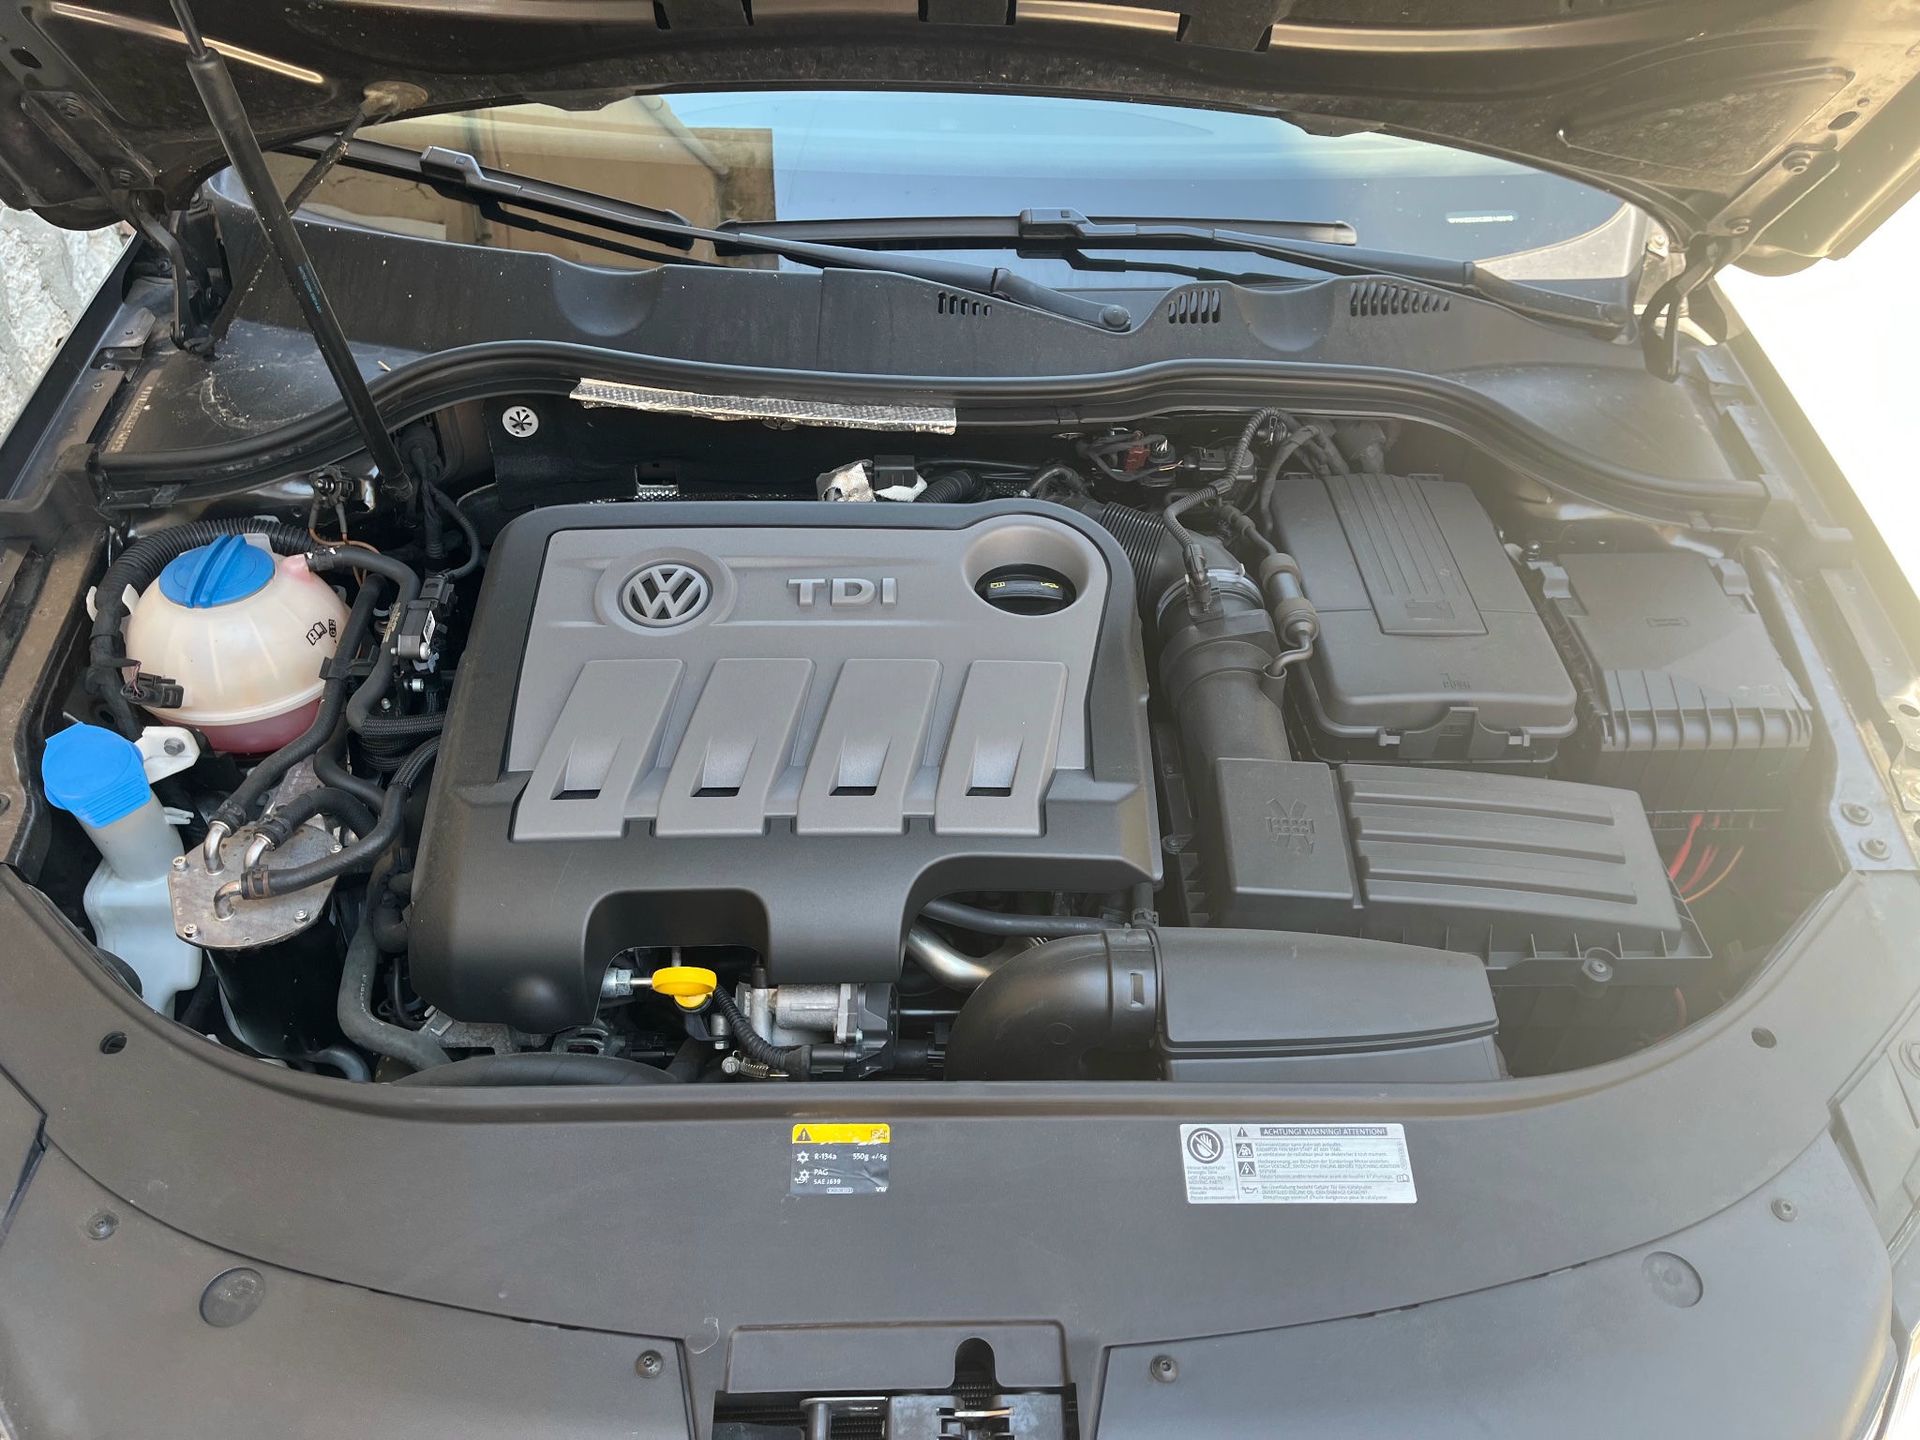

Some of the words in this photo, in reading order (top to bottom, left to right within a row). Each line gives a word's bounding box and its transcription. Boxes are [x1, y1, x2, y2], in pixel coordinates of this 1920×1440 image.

[622, 563, 710, 627] VW
[787, 577, 898, 607] TDI
[1263, 1128, 1302, 1136] ACHTUNG!
[1303, 1128, 1342, 1136] WARNING!
[1343, 1128, 1386, 1136] ATTENTION!
[814, 1152, 837, 1160] R-134a
[813, 1168, 829, 1176] PAG
